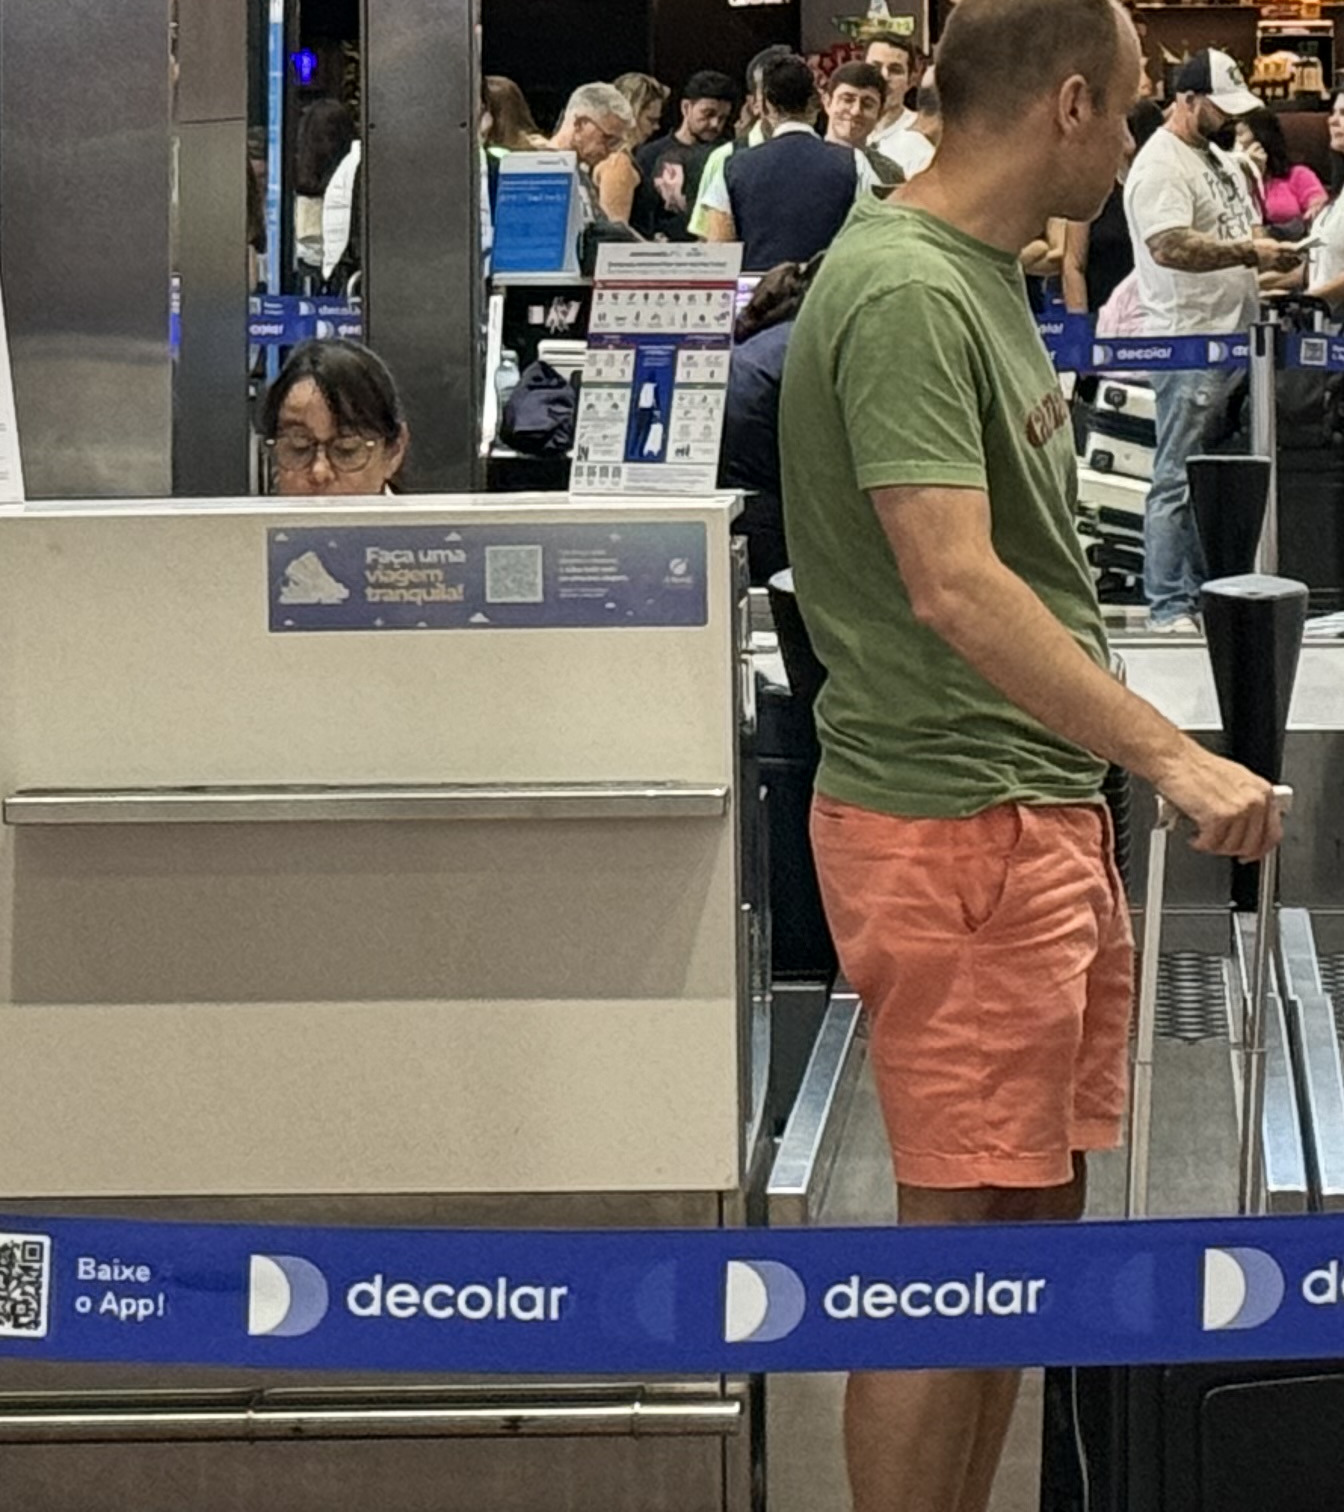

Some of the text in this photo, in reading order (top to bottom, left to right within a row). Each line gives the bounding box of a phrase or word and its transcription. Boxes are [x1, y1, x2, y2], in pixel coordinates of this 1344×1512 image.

[364, 546, 467, 569] Faça uma
[364, 568, 444, 587] viagem
[364, 584, 465, 607] tranquila!
[76, 1257, 151, 1284] Baixe
[74, 1291, 165, 1320] o App!
[346, 1274, 568, 1322] decolar
[823, 1272, 1045, 1319] decolar
